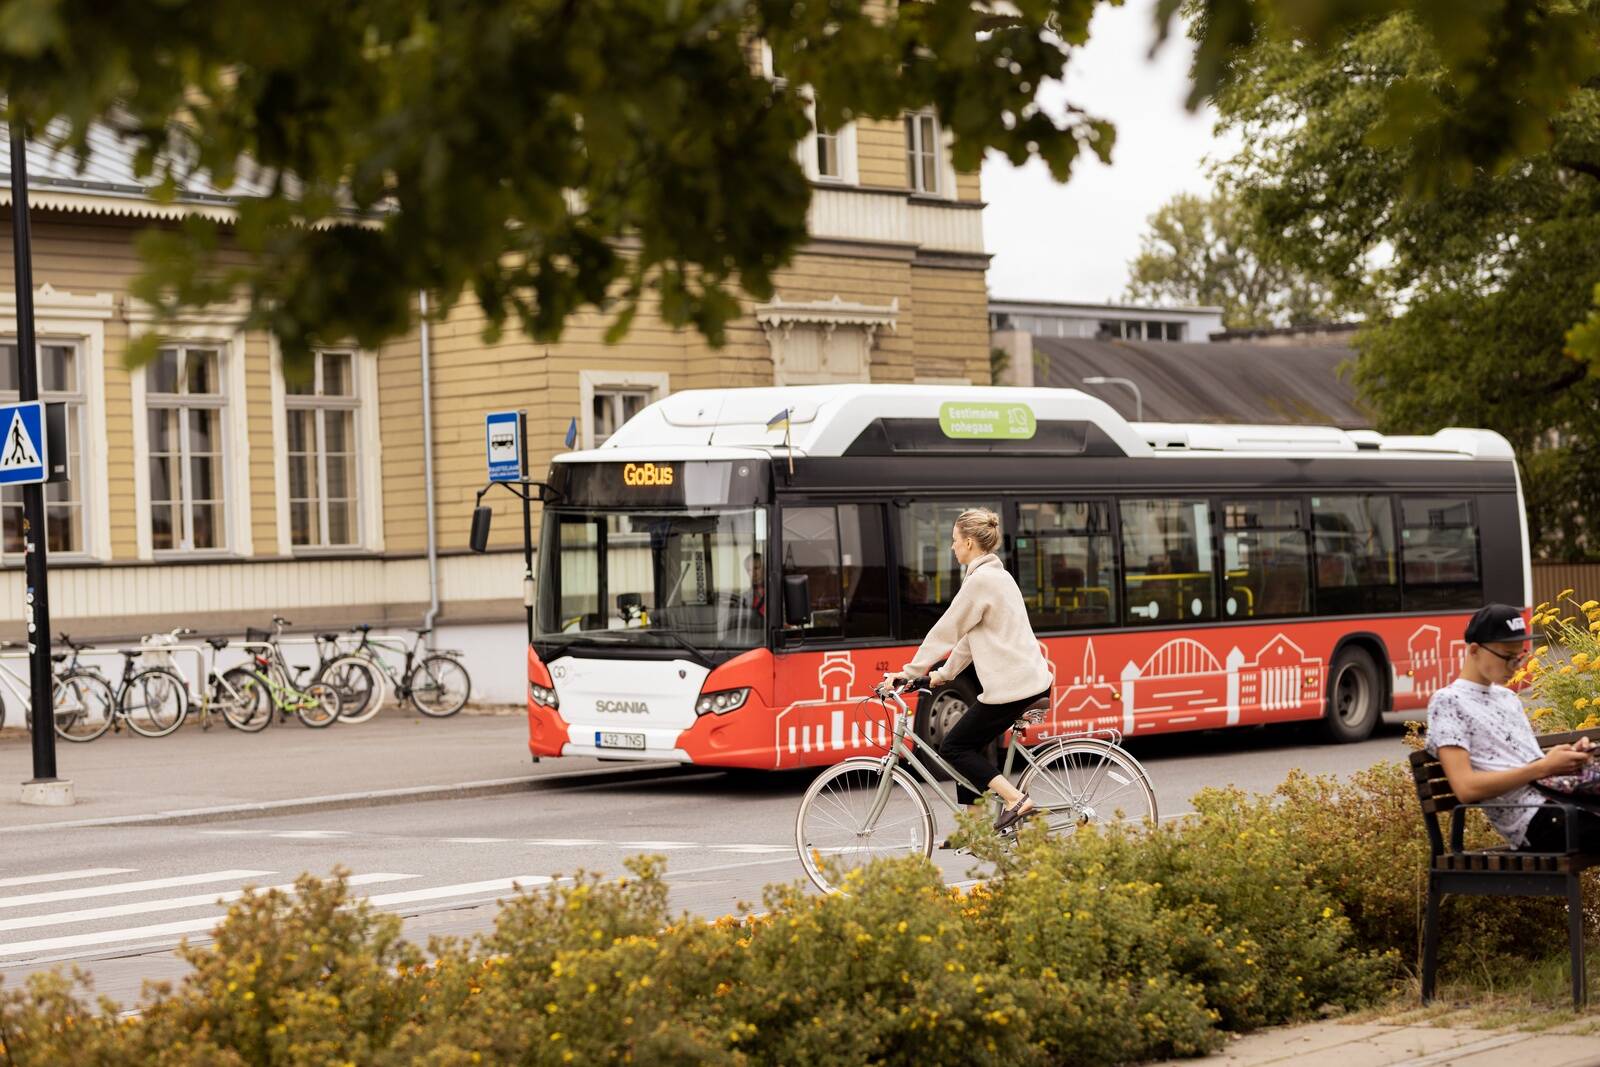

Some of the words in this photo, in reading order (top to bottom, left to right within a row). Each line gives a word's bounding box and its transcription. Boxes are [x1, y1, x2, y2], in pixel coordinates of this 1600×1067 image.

[624, 463, 673, 485] GoBus
[876, 661, 889, 671] 432
[596, 700, 649, 714] SCANIA
[603, 734, 619, 746] 432
[624, 735, 642, 747] TNS
